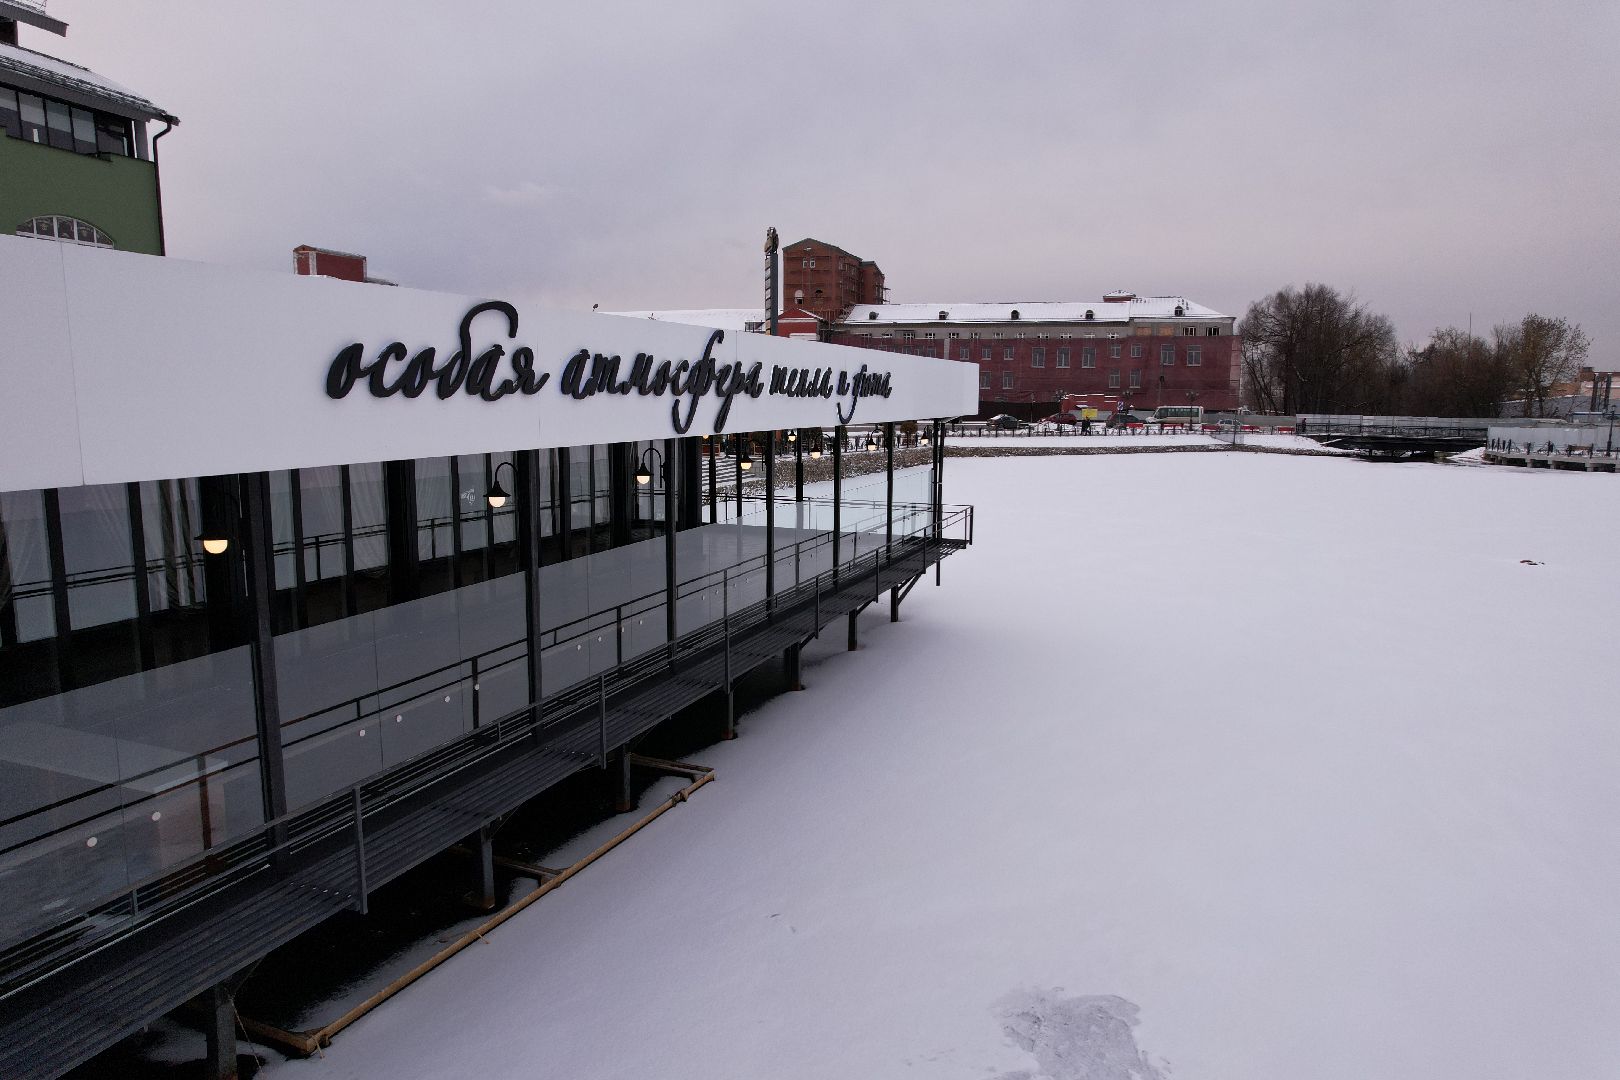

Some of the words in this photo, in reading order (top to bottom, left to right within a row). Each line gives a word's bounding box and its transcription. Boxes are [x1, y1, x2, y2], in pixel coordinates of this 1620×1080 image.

[326, 300, 550, 401] особая
[561, 329, 764, 434] атмосфера
[769, 364, 833, 399] тепла
[837, 371, 850, 396] и
[837, 364, 892, 424] уюта
